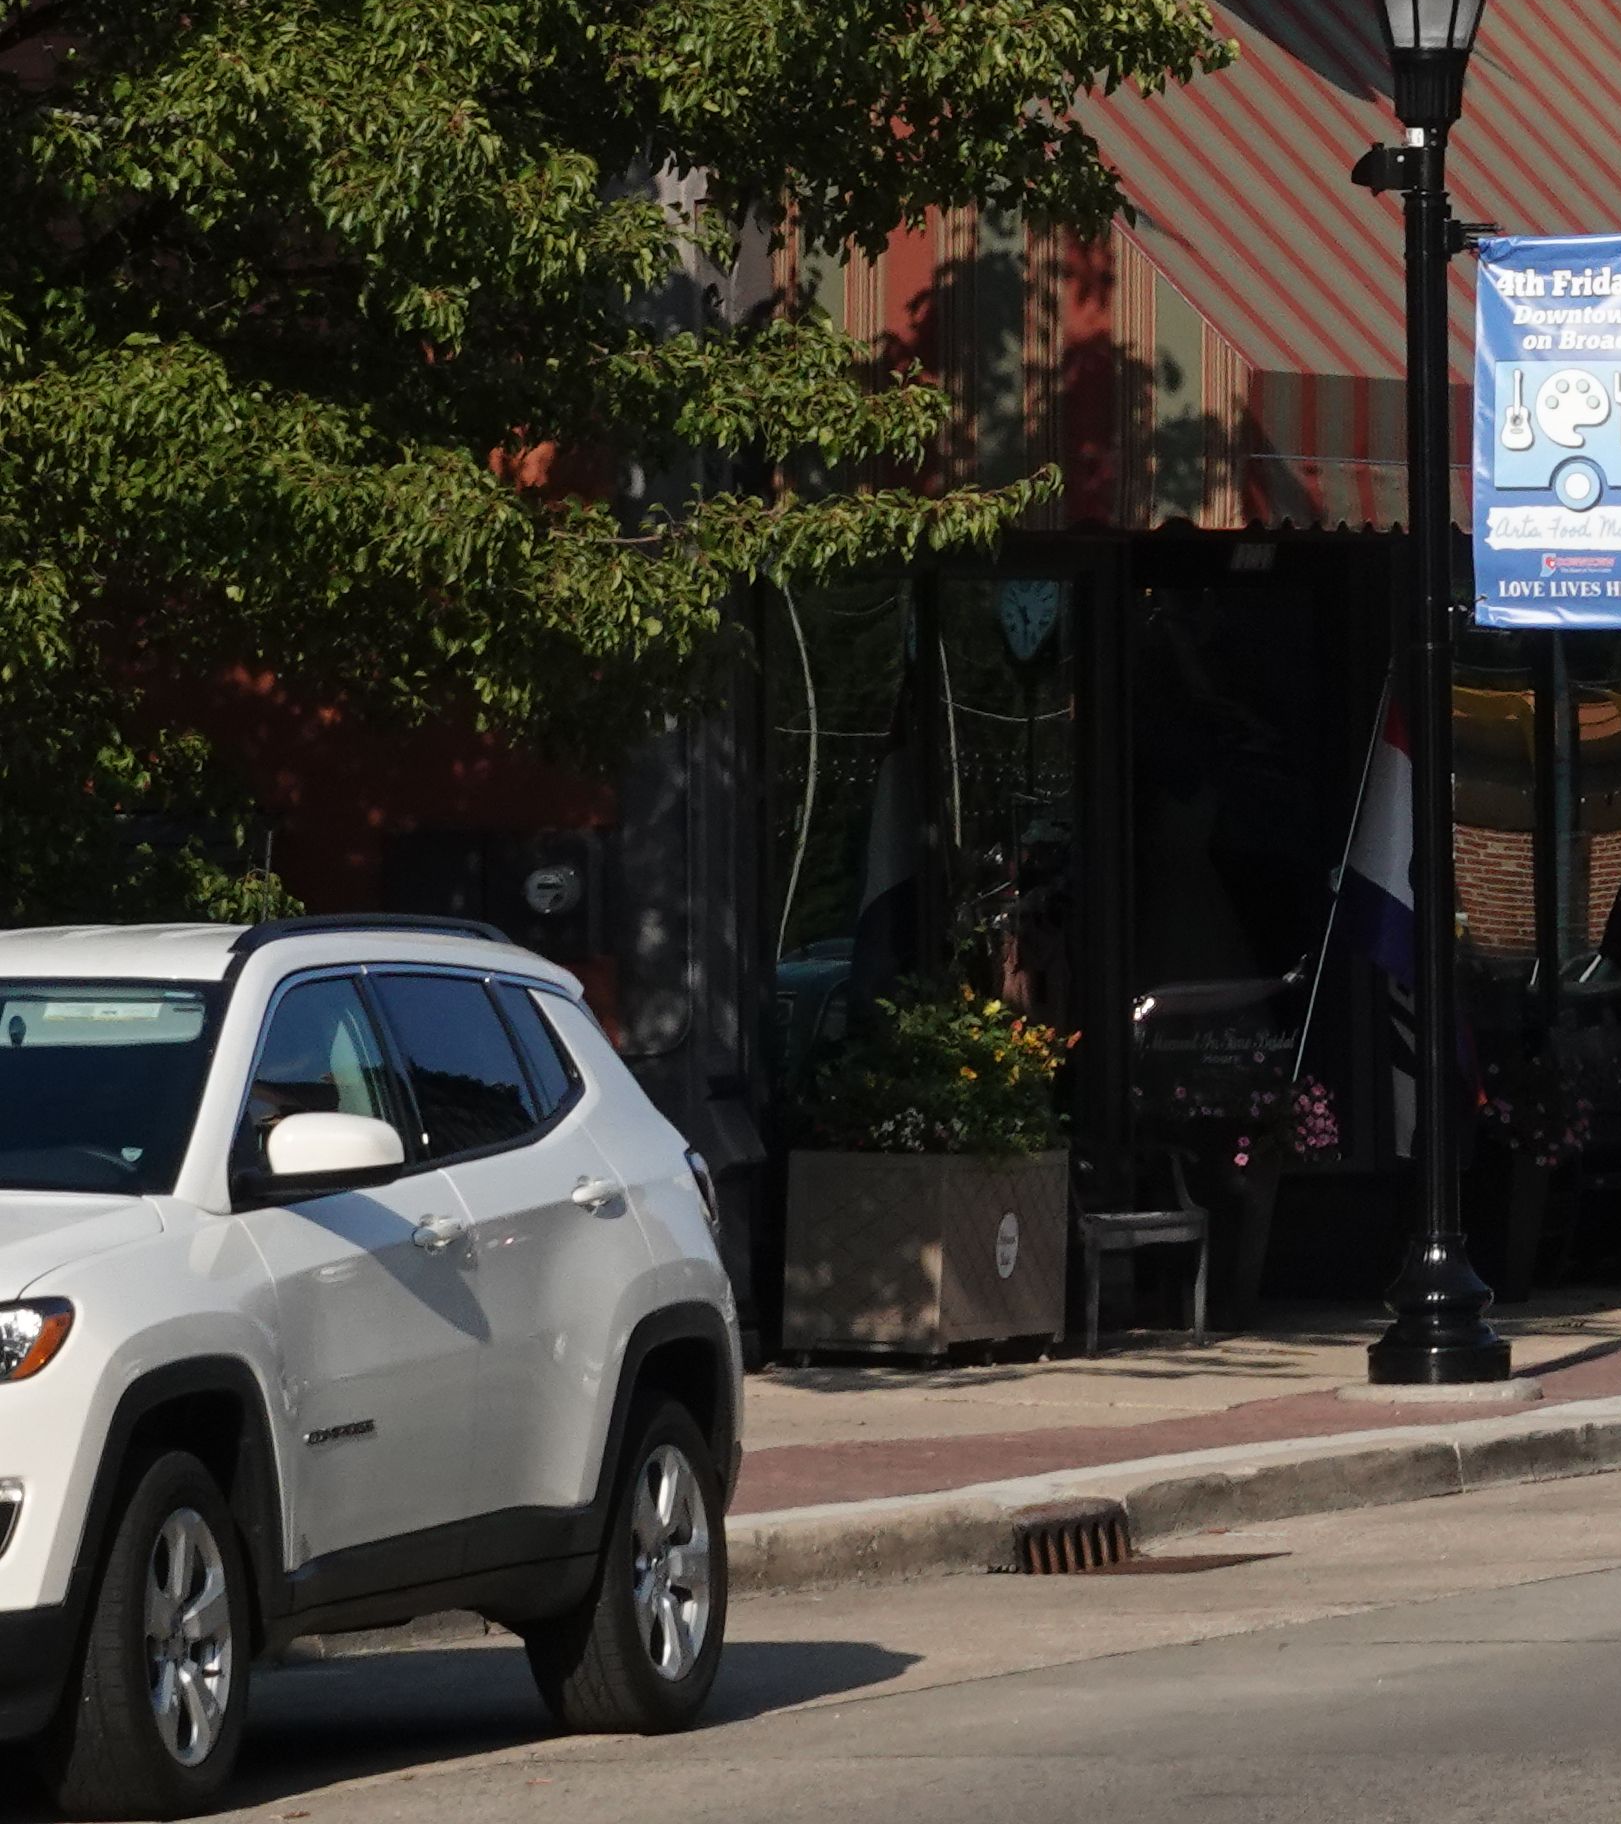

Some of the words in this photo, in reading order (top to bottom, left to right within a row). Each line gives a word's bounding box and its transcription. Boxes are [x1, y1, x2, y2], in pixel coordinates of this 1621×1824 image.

[1497, 269, 1546, 297] 4th
[1522, 335, 1552, 351] on
[1499, 580, 1546, 598] LOVE
[1550, 580, 1602, 598] LIVES
